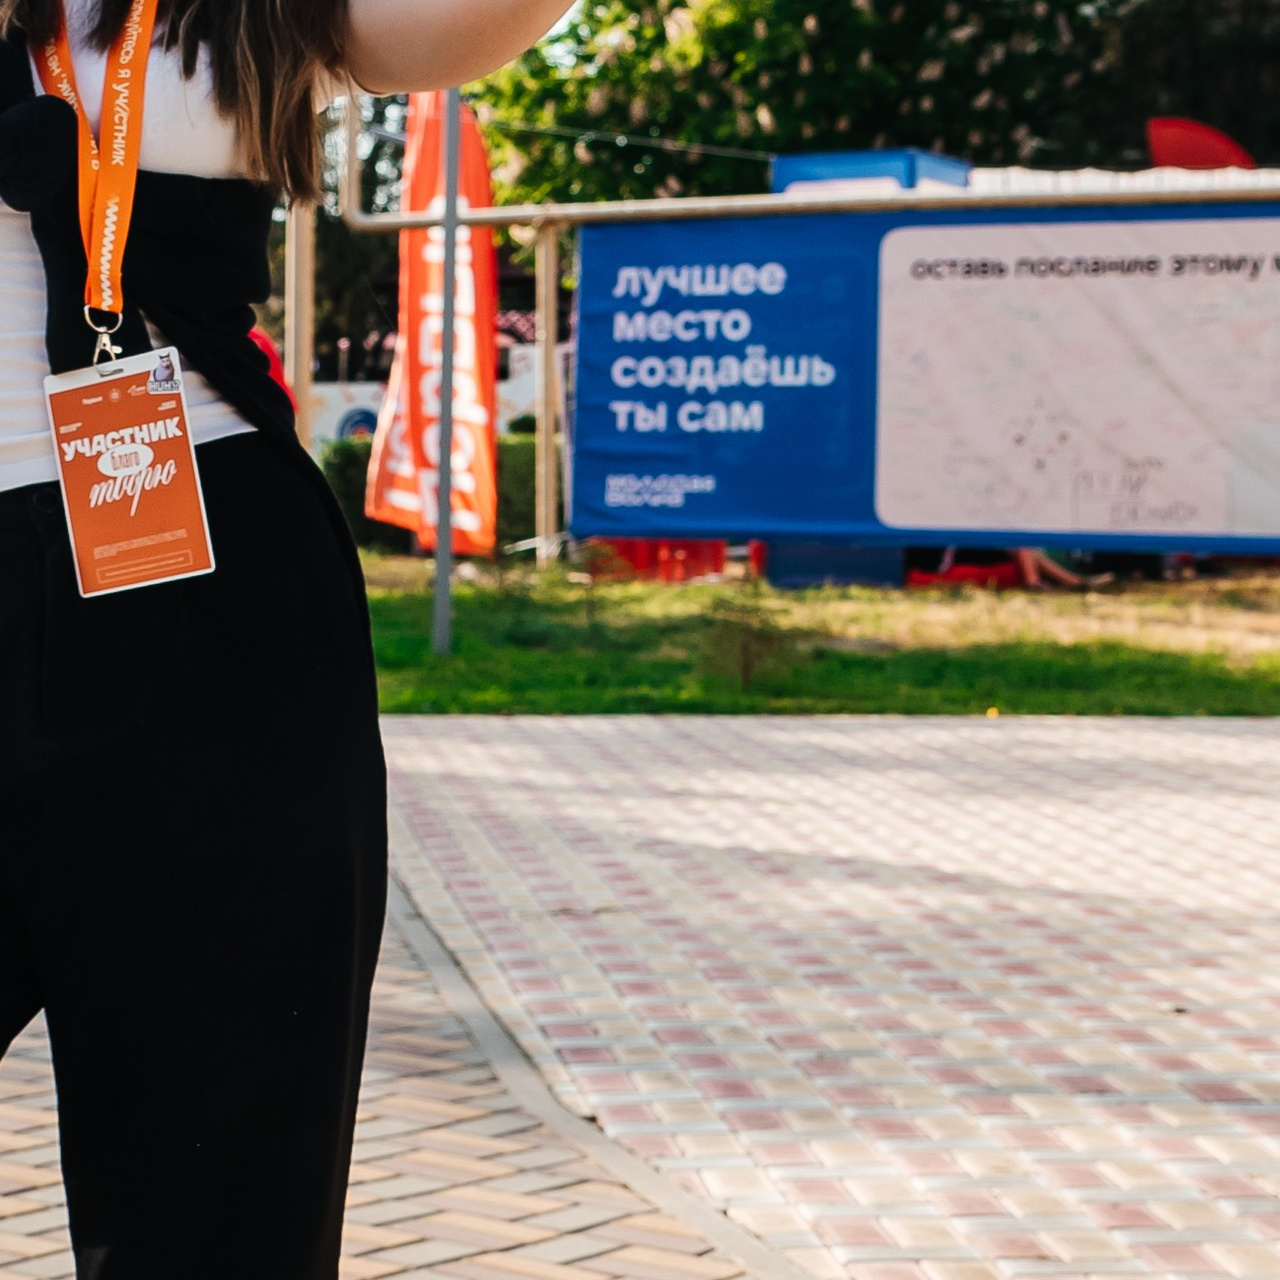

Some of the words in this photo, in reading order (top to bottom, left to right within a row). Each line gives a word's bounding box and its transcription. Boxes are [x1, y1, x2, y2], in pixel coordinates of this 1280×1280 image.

[612, 262, 787, 308] лучшее
[909, 256, 1009, 281] оставь
[1015, 253, 1162, 280] послание
[1168, 251, 1266, 283] этому
[612, 308, 752, 342] место
[610, 344, 837, 395] создаёшь
[60, 416, 183, 462] УЧАСТНИК
[609, 400, 668, 433] ты
[677, 400, 765, 433] сам
[89, 459, 177, 517] творю
